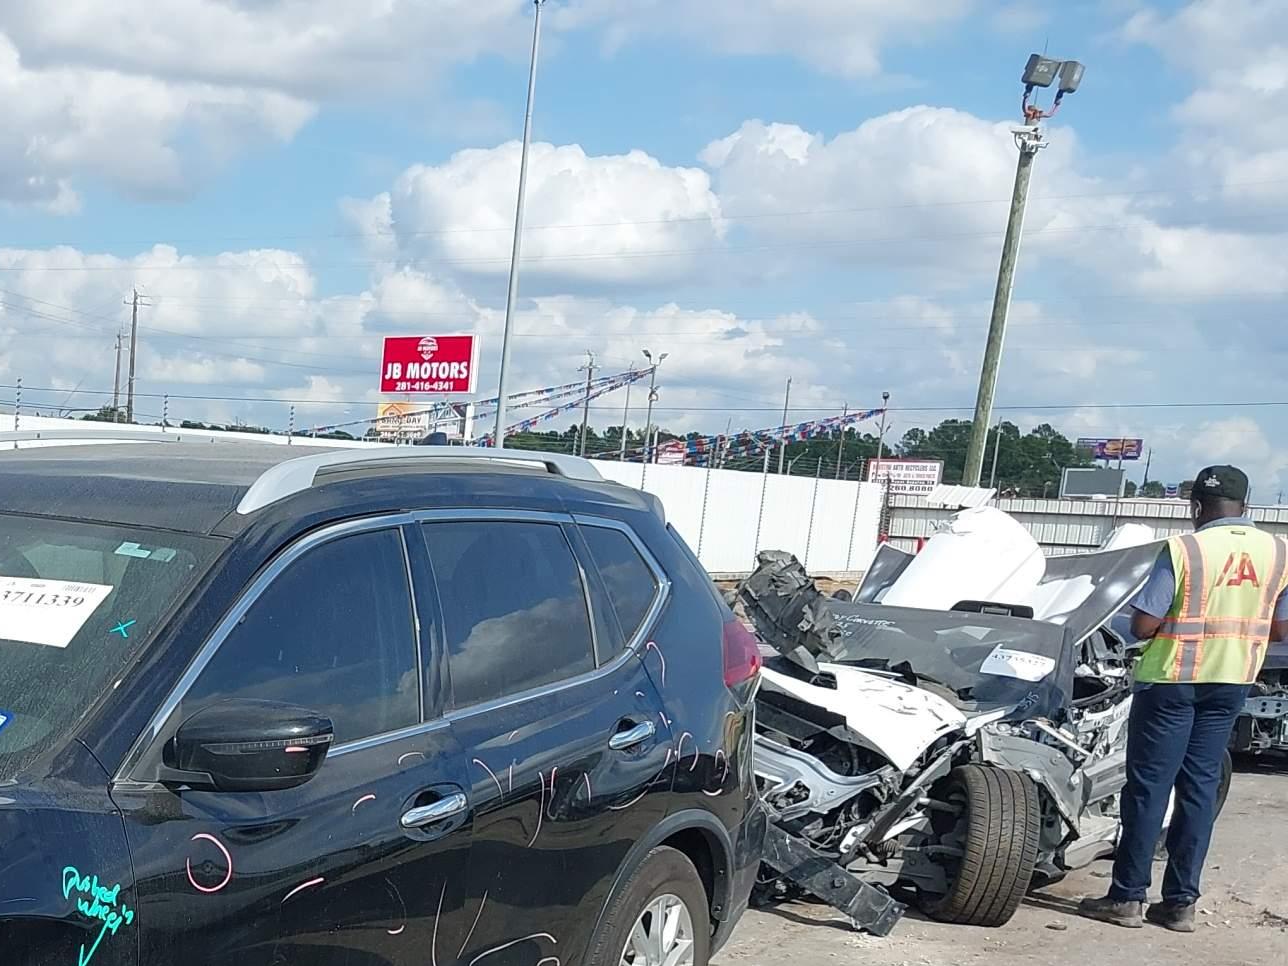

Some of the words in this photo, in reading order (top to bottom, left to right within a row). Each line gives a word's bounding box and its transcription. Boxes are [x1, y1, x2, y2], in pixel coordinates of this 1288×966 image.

[384, 362, 402, 379] JB
[406, 361, 468, 379] MOTORS
[395, 381, 454, 391] 281-416-4341
